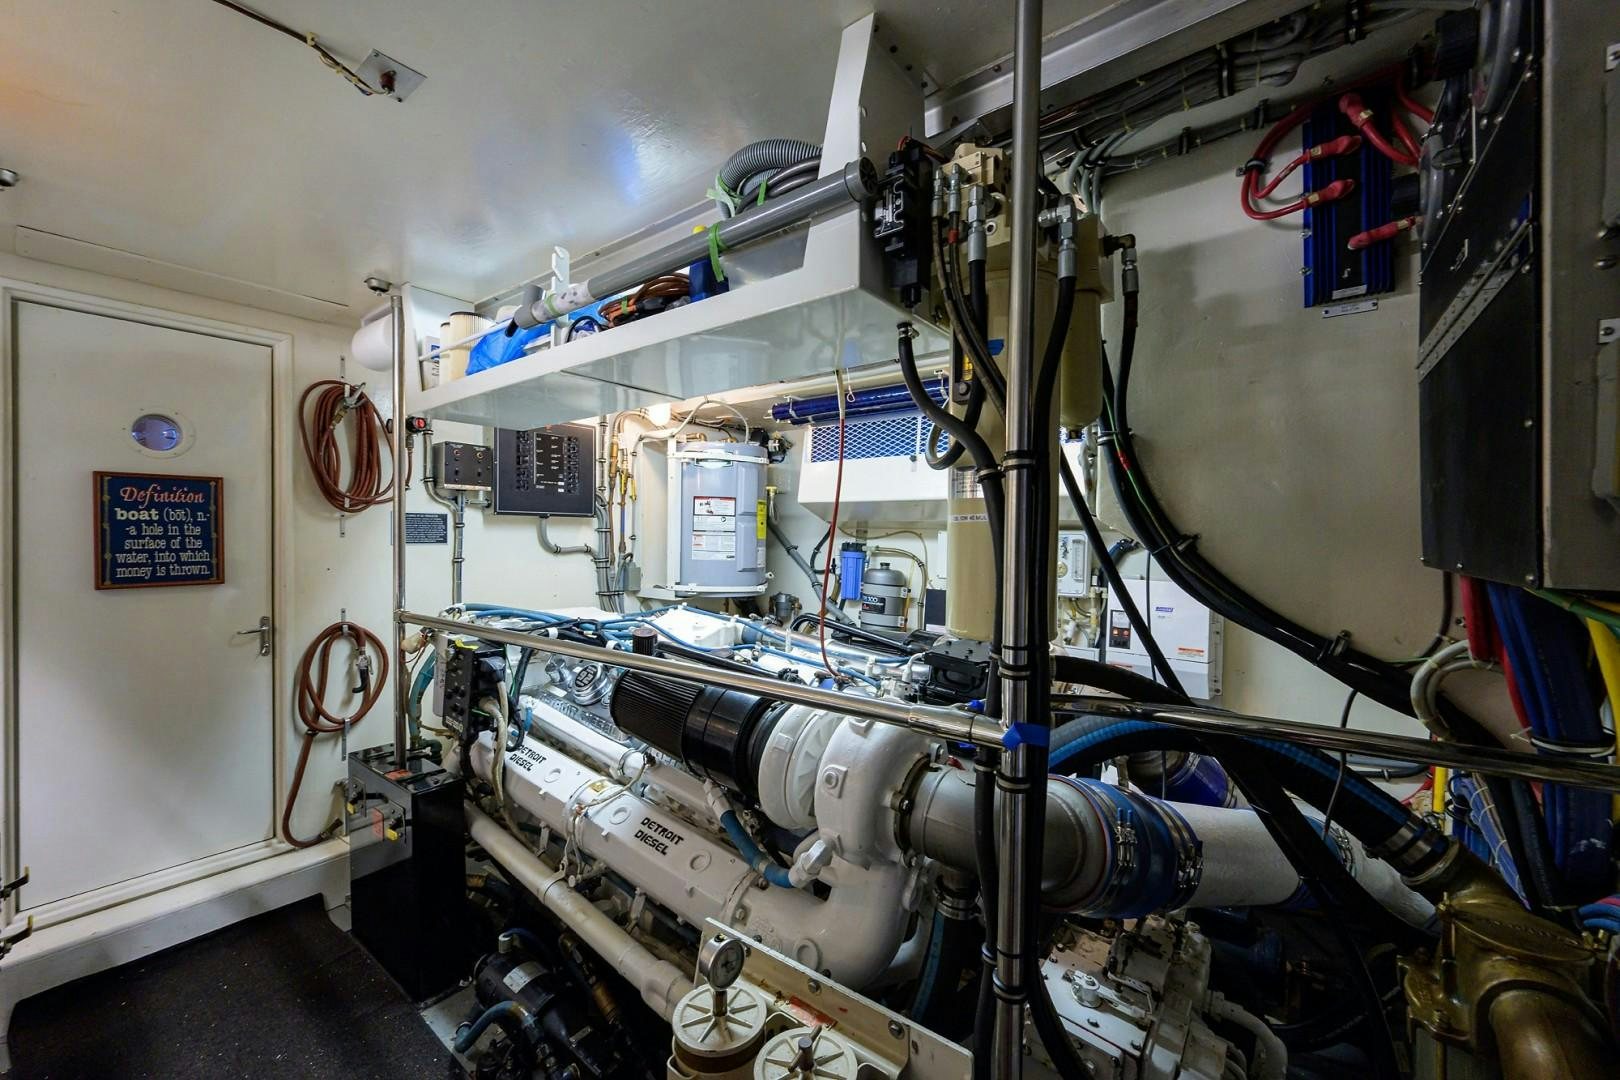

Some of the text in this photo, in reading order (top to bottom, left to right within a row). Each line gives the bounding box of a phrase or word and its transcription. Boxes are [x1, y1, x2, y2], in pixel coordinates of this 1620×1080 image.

[120, 484, 205, 508] Definition
[115, 508, 159, 520] boat
[142, 524, 163, 535] hole
[168, 525, 179, 535] in
[184, 524, 201, 535] the
[125, 537, 202, 549] surface of the
[115, 550, 209, 564] water, into which
[116, 564, 210, 579] money is thrown.
[510, 754, 533, 771] DIESEL
[641, 817, 684, 845] DETROIT
[635, 830, 668, 855] DIESEL
